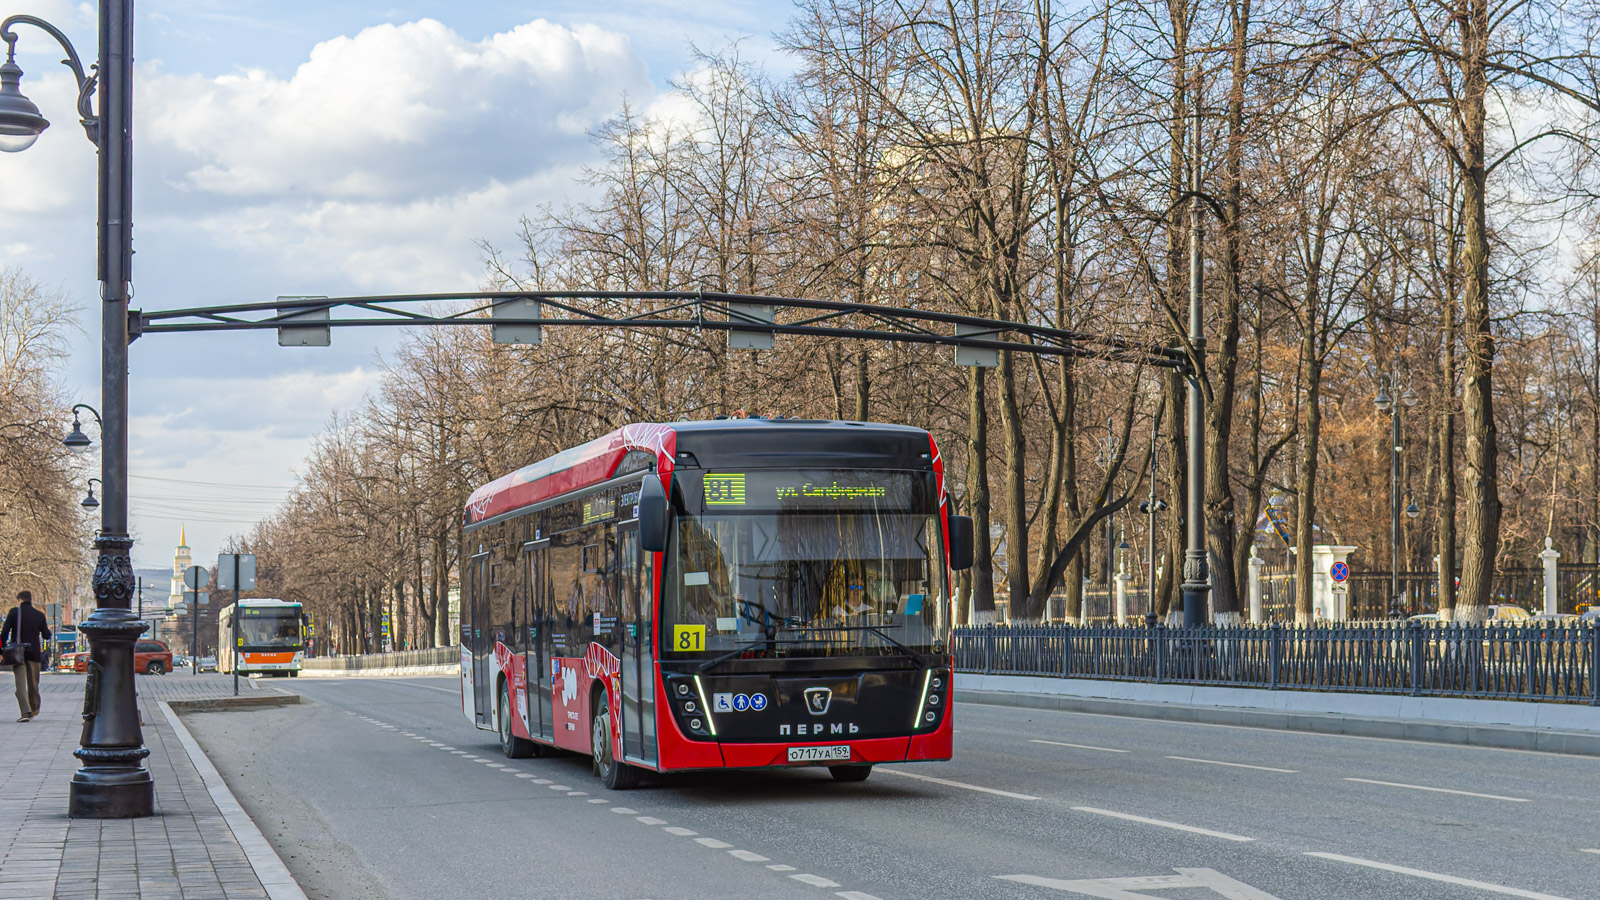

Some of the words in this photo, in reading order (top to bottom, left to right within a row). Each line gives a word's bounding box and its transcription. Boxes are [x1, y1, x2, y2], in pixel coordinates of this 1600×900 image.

[709, 480, 736, 500] 81
[679, 631, 700, 650] 81
[780, 723, 859, 735] ПЕРМЬ
[832, 746, 847, 755] 159
